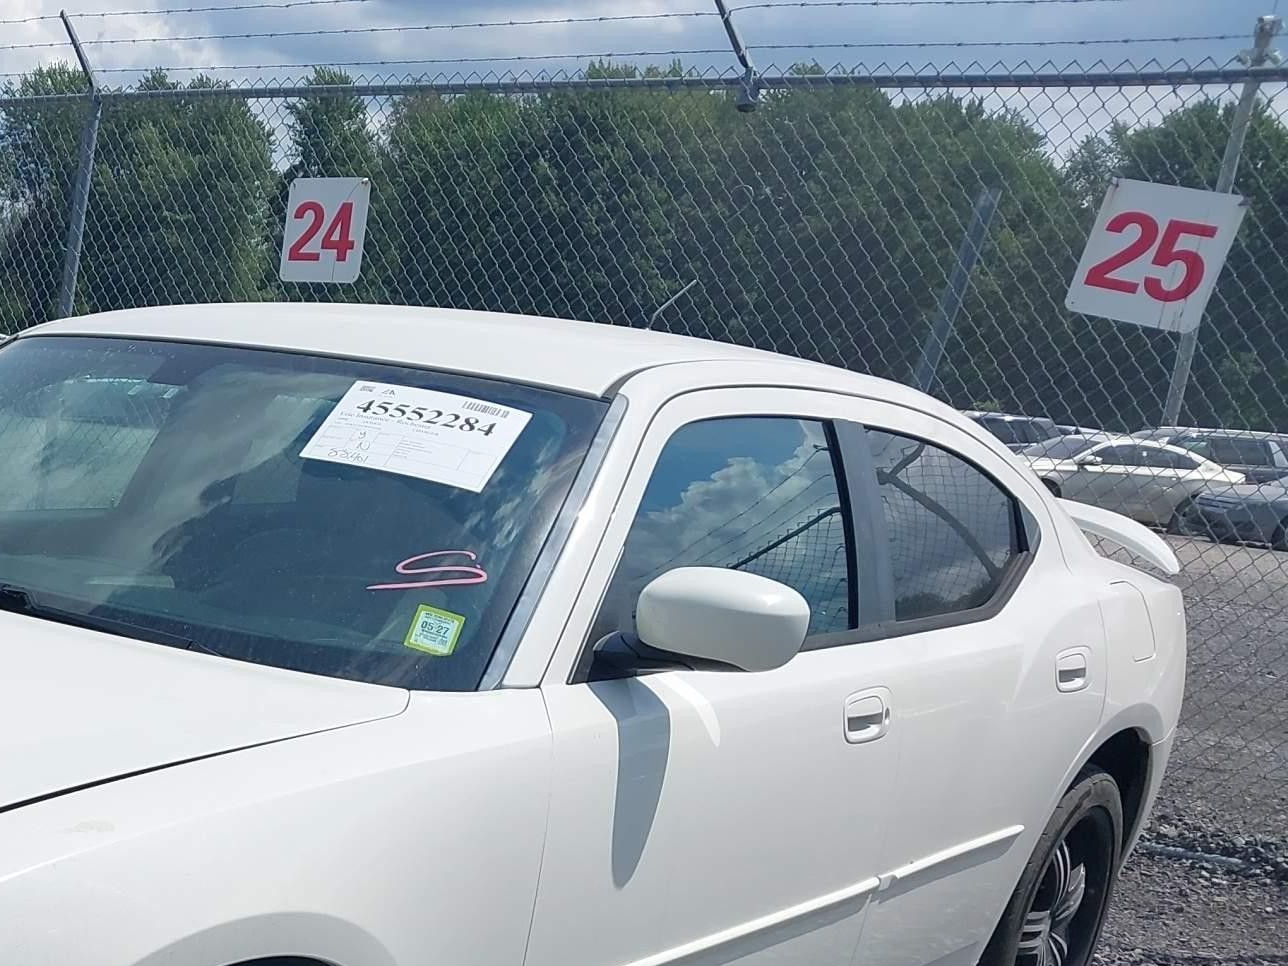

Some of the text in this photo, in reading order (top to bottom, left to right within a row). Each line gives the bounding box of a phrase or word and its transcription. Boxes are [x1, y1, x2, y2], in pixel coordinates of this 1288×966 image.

[288, 201, 355, 262] 24
[1084, 211, 1218, 302] 25
[356, 399, 498, 437] 45552284
